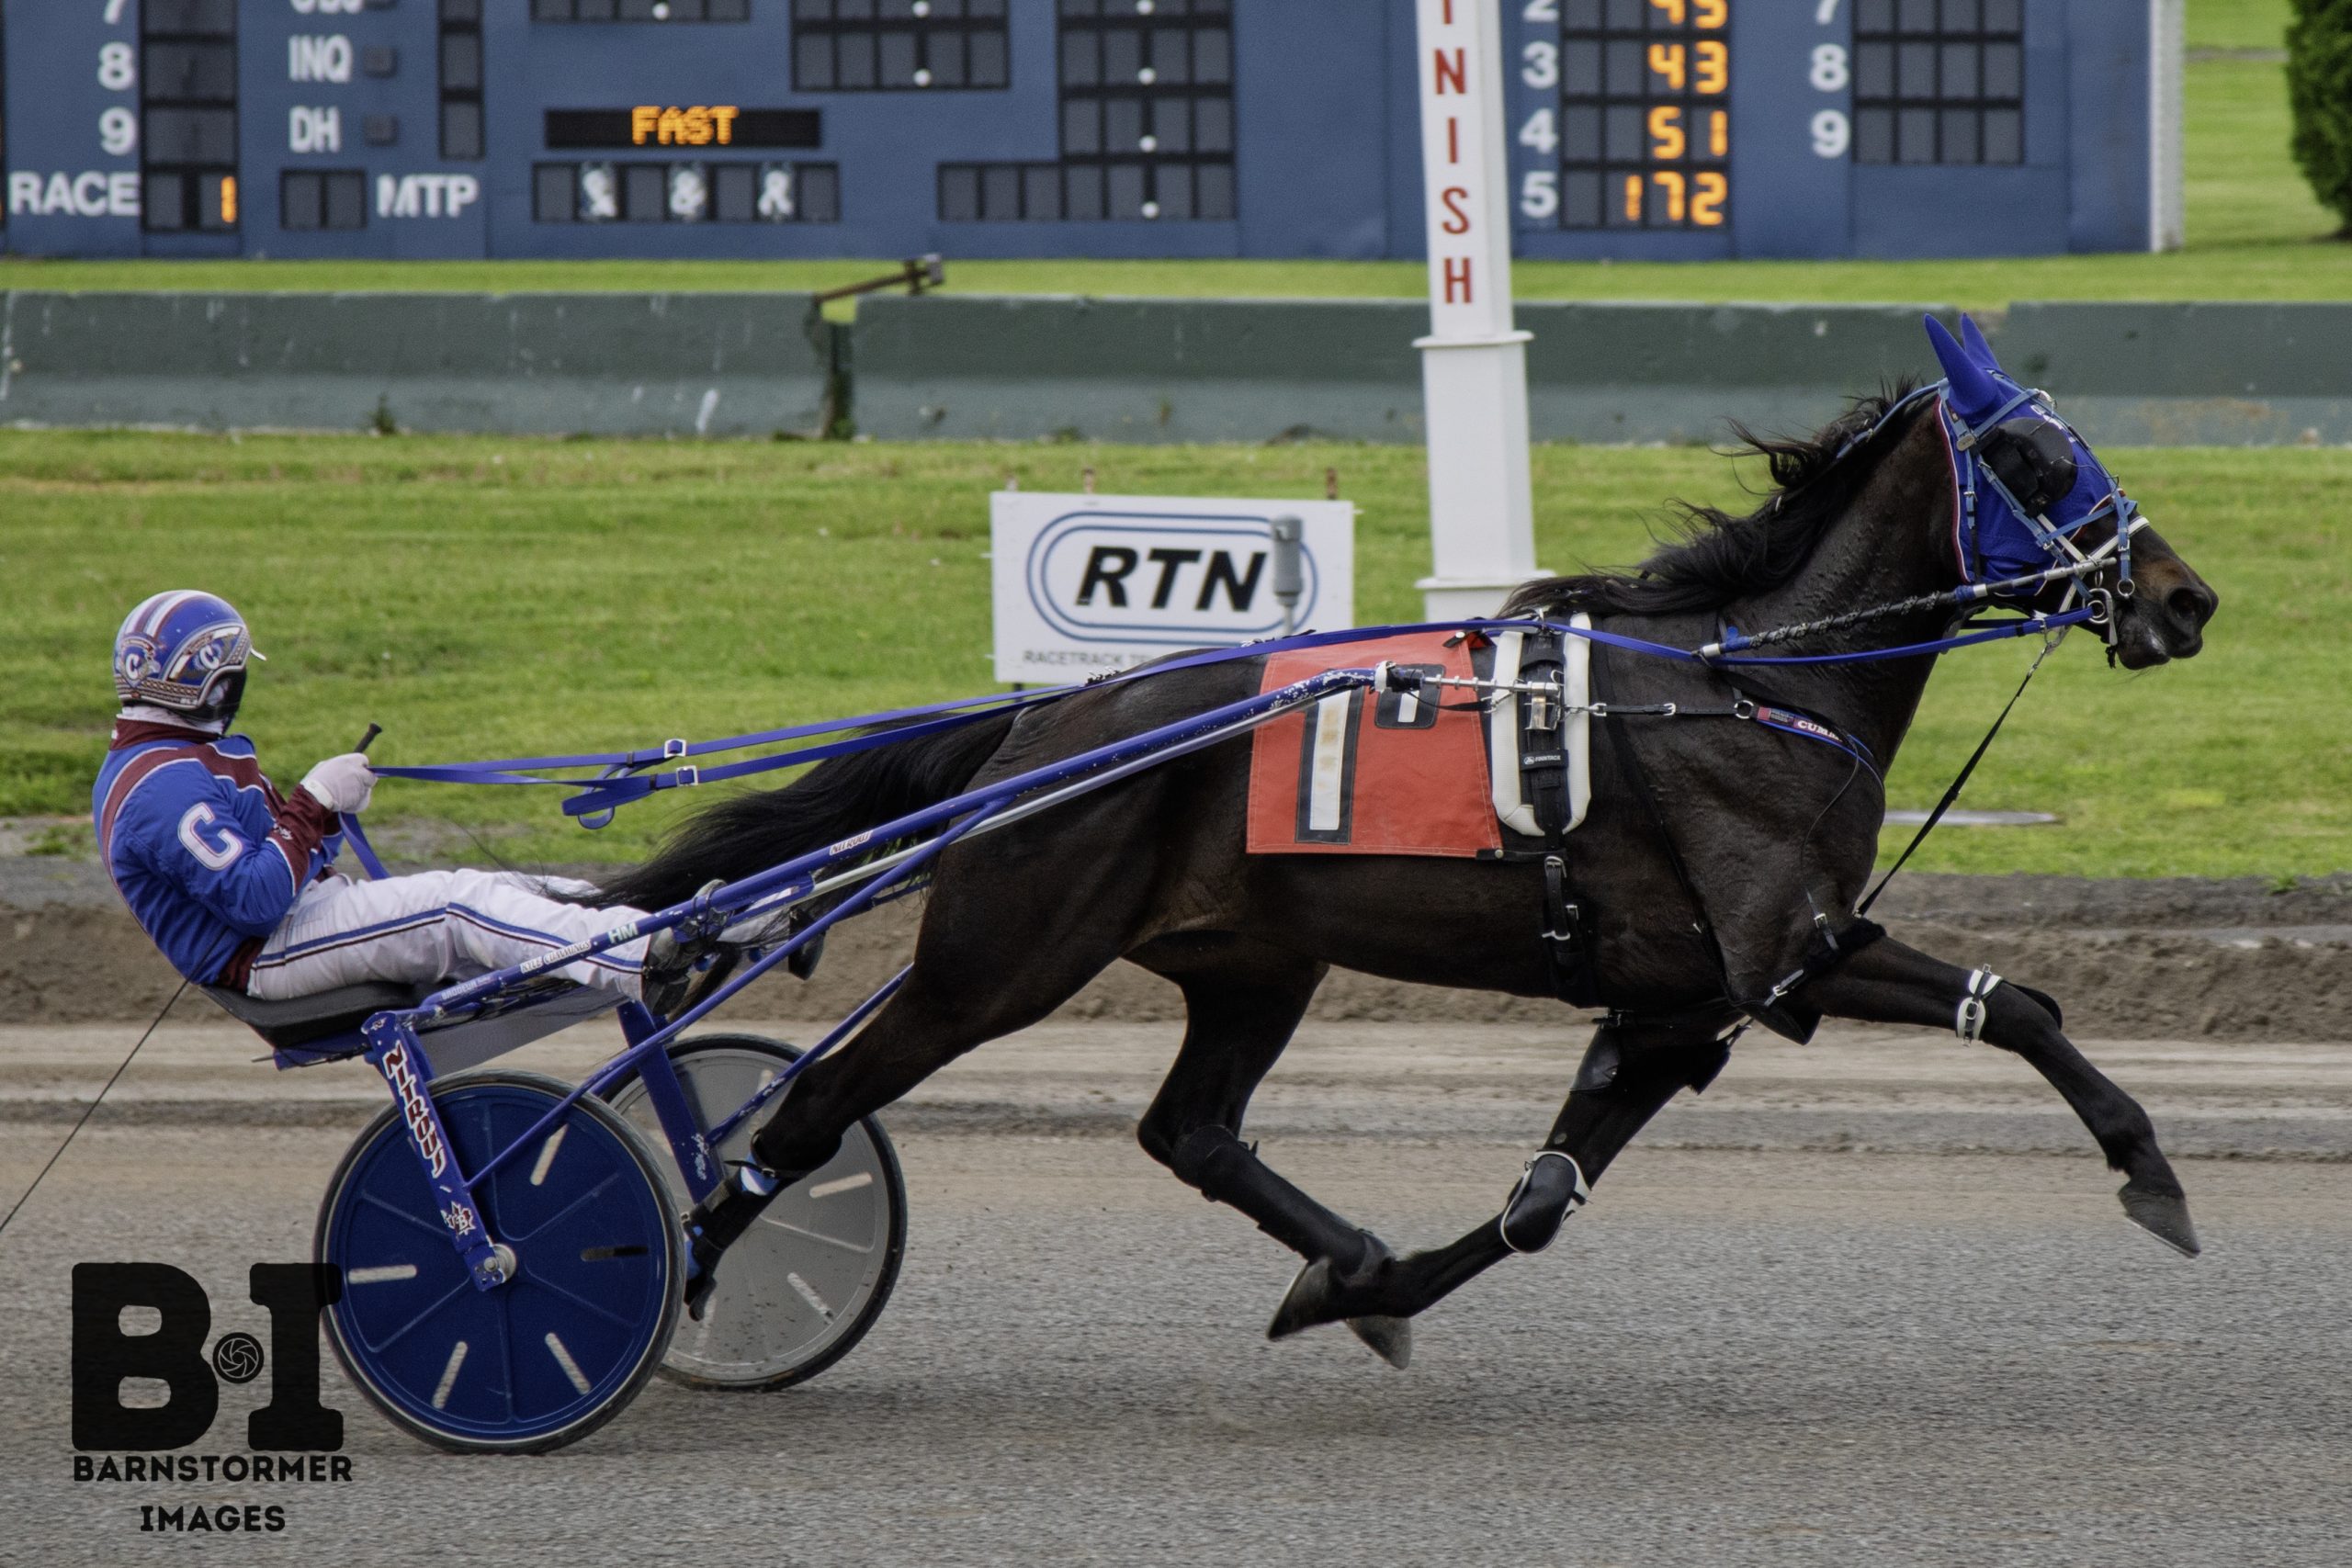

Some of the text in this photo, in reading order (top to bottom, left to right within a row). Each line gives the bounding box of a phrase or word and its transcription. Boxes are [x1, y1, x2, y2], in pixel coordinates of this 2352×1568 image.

[97, 42, 135, 90] 8
[288, 36, 352, 83] INQ
[1521, 40, 1727, 93] 3 43
[1810, 44, 1849, 91] 8
[98, 107, 138, 155] 9
[288, 107, 341, 153] DH
[631, 106, 739, 145] FAST
[1520, 107, 1727, 159] 4 51
[1811, 109, 1850, 157] 9
[8, 172, 236, 223] RACE 1
[377, 175, 479, 217] MTP
[1521, 171, 1727, 225] 5 172
[1074, 546, 1268, 613] RTN
[1023, 650, 1122, 665] RACETRACK
[177, 802, 243, 871] C
[607, 922, 639, 944] HM
[382, 1040, 447, 1179] NITROUS
